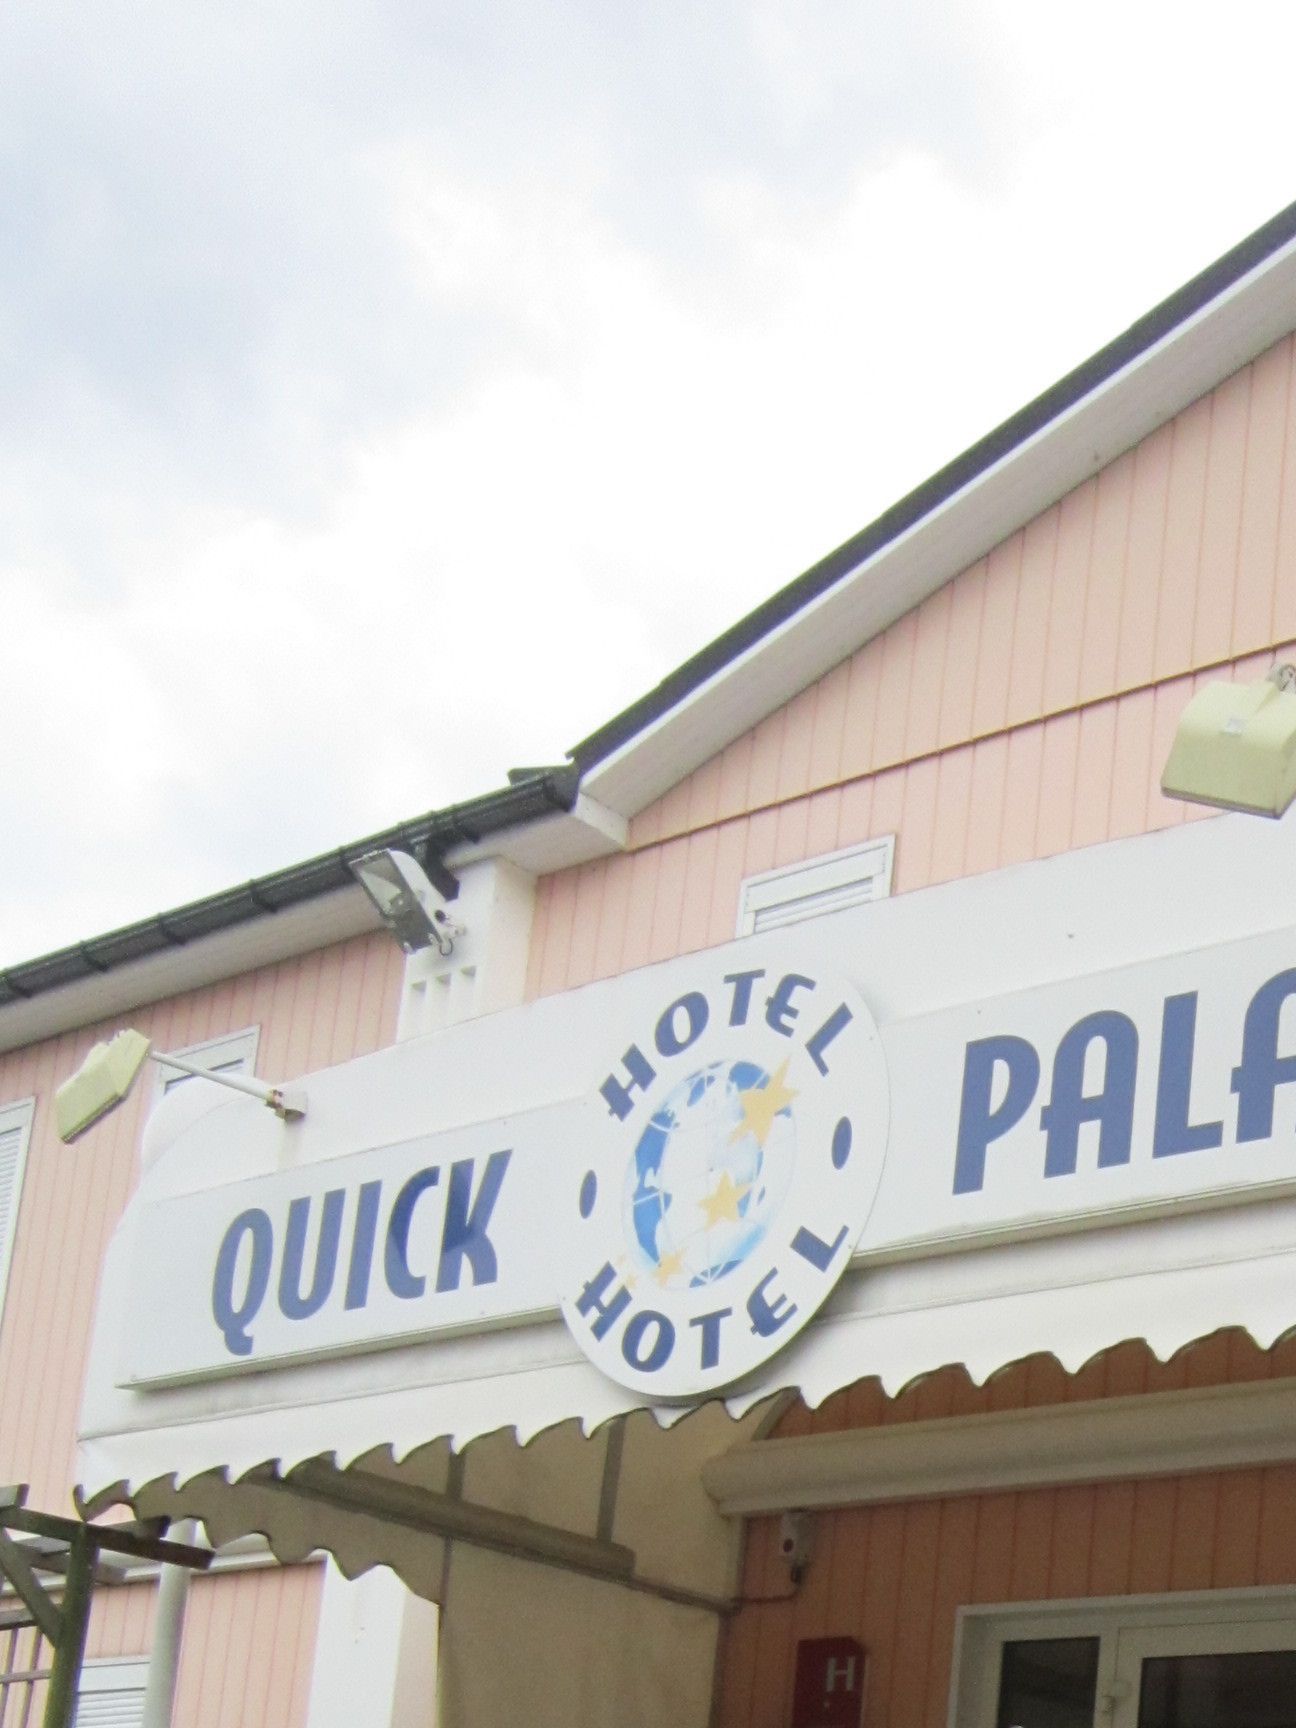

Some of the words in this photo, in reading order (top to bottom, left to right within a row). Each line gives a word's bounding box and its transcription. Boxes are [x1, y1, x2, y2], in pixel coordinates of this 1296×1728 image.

[599, 968, 854, 1121] HOTEL
[210, 1148, 514, 1357] QUICK
[575, 1224, 850, 1373] HOTEL
[825, 1655, 856, 1693] H
